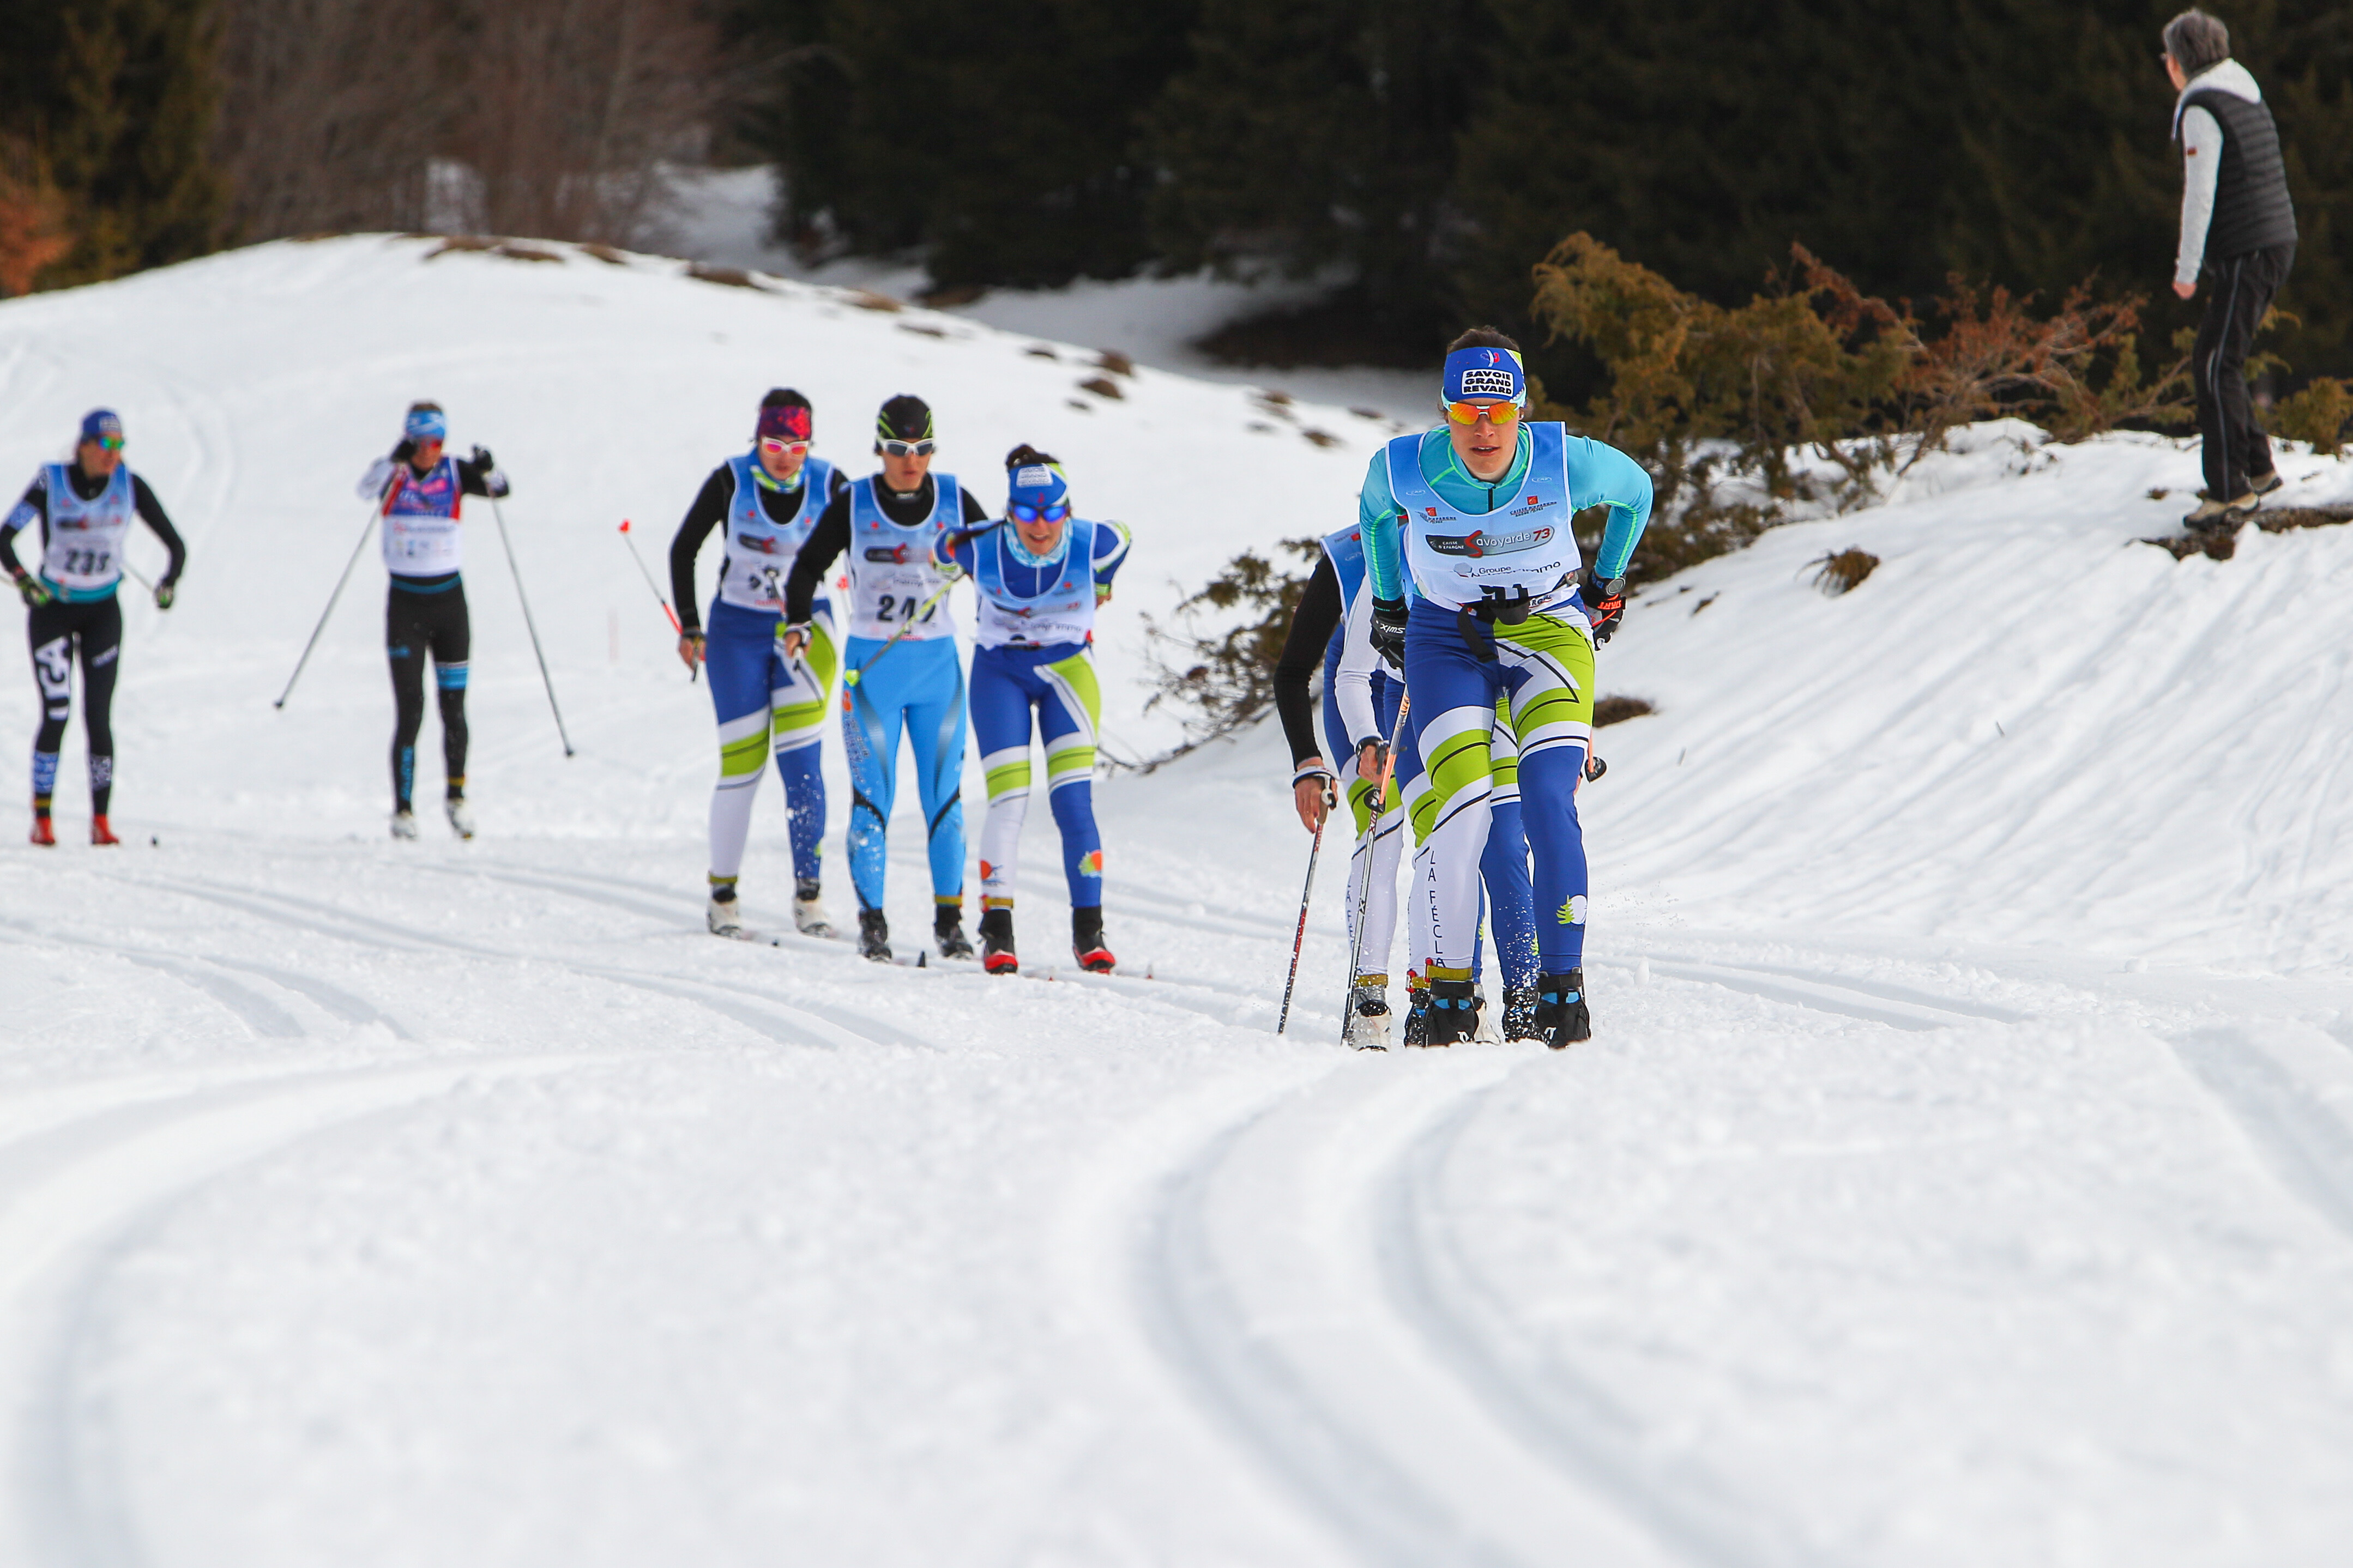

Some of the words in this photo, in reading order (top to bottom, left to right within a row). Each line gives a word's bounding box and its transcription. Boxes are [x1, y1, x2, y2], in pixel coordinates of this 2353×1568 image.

[1466, 371, 1511, 380] SAVOIE
[1465, 378, 1511, 386] GRAND
[1464, 385, 1512, 394] REVARD
[1533, 528, 1550, 542] 73
[1479, 566, 1512, 574] Groupe
[1597, 600, 1622, 610] START
[1428, 850, 1437, 882] LA
